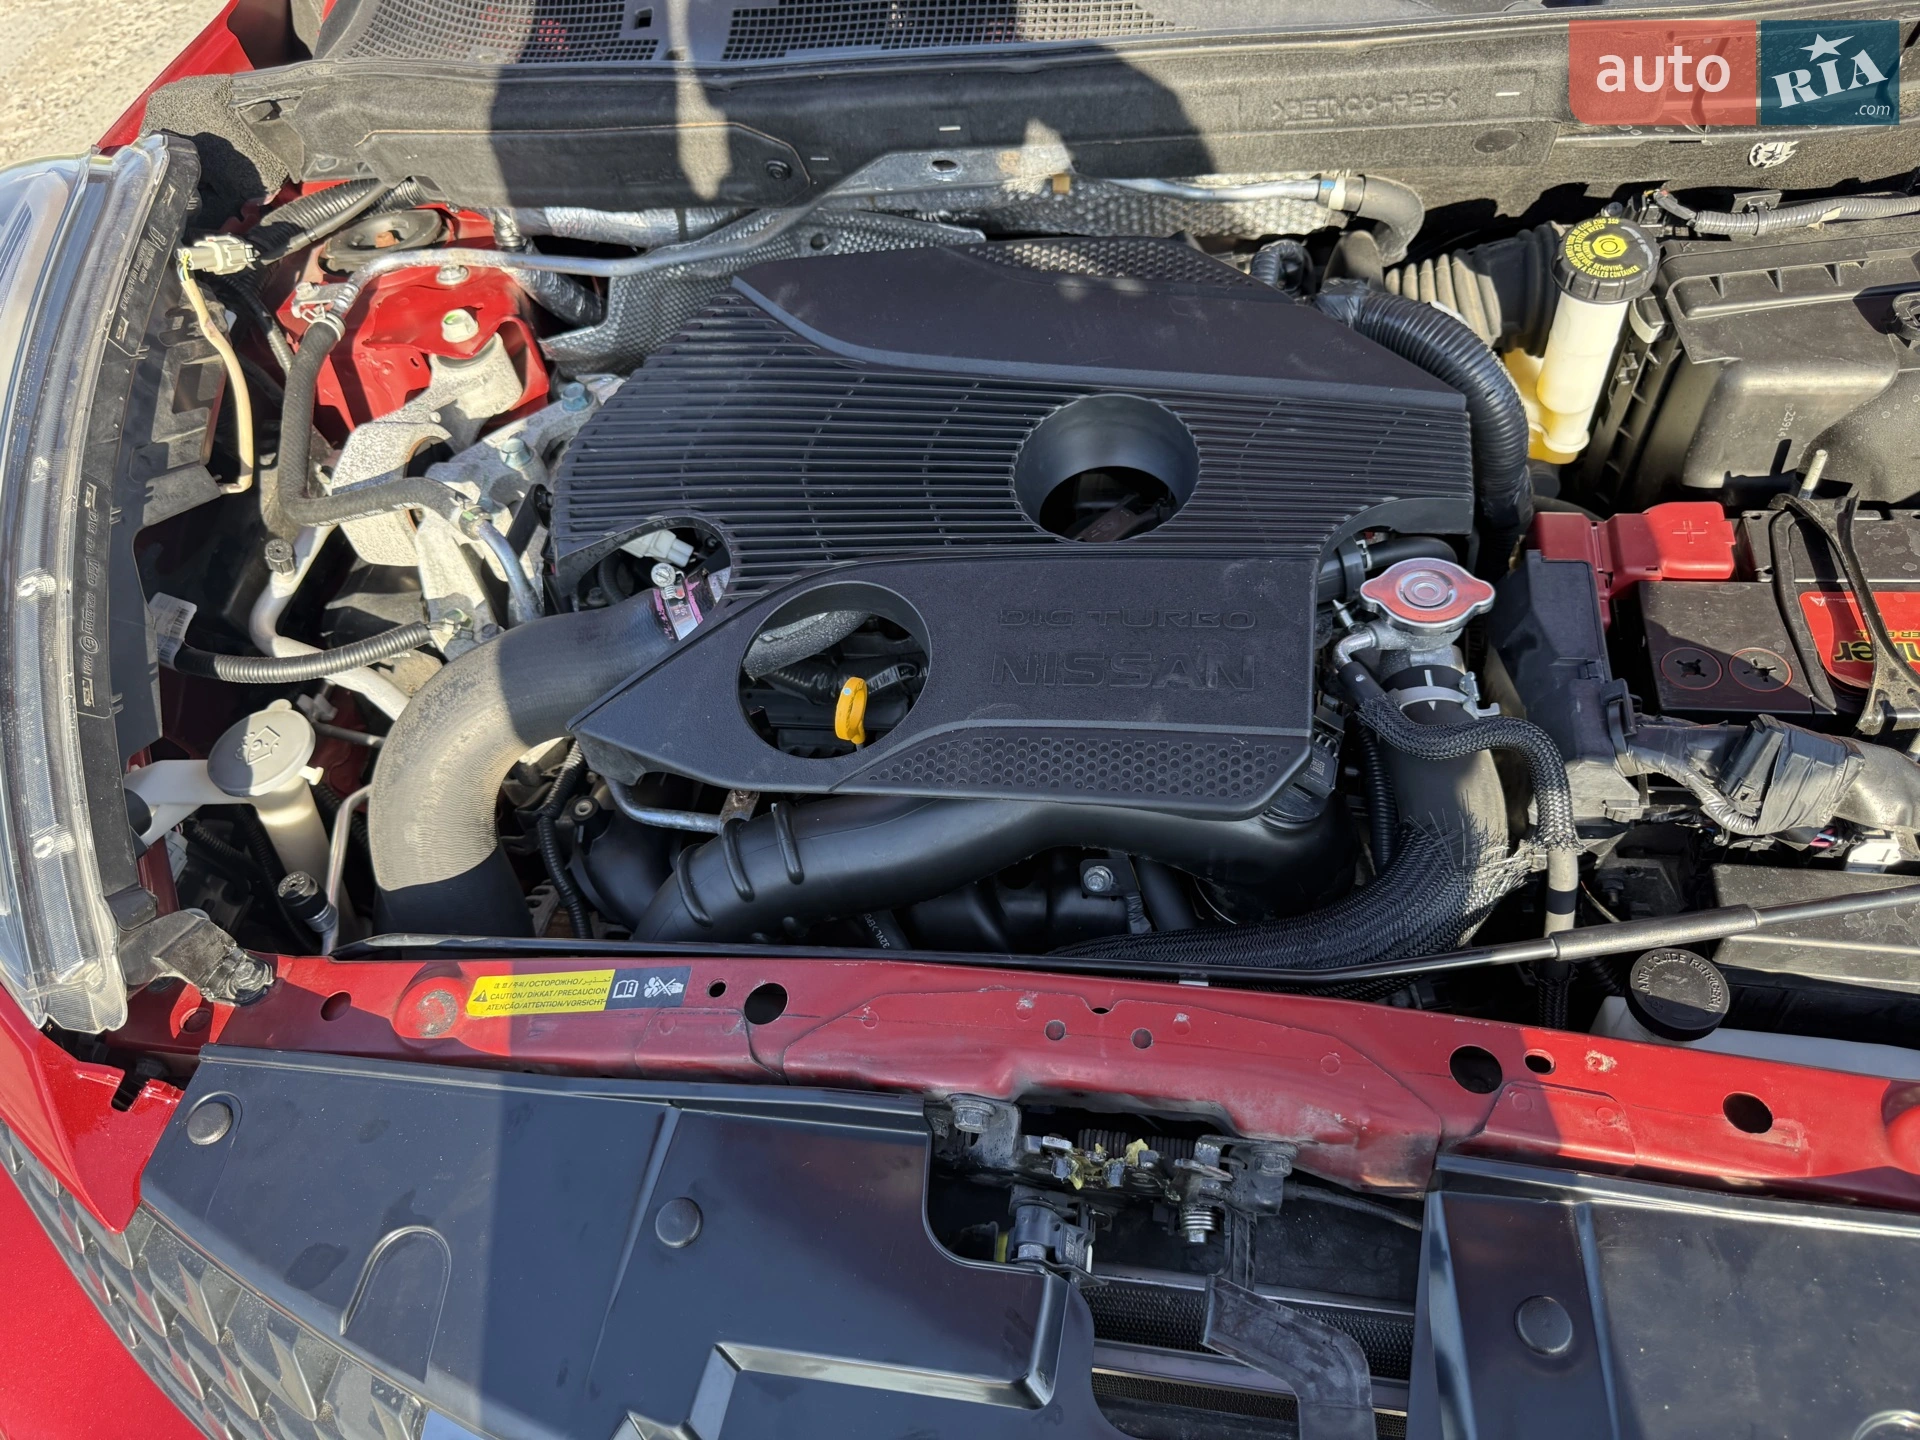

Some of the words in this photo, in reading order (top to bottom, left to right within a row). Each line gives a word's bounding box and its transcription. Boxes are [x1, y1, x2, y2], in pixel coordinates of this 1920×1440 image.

[1585, 267, 1608, 277] SEALED
[1609, 264, 1641, 277] CONTAINER
[1591, 262, 1623, 271] REMOVING
[1000, 609, 1074, 627] DIG
[1086, 609, 1256, 629] TURBO
[990, 651, 1254, 691] NISSAN
